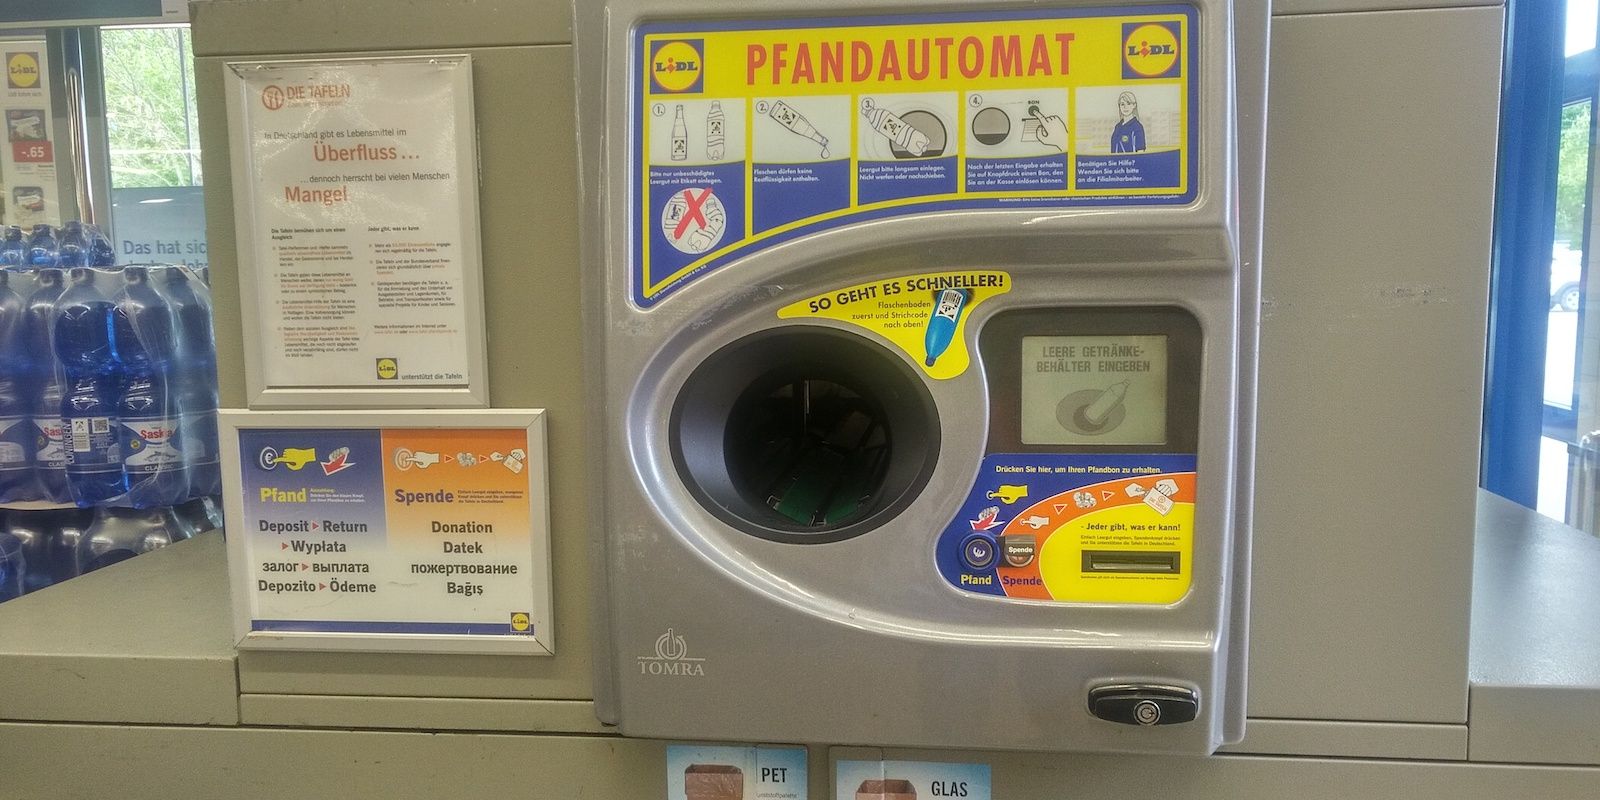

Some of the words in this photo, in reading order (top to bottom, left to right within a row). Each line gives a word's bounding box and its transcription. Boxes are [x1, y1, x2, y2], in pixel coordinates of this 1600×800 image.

[1128, 41, 1174, 58] LIDL
[747, 33, 1075, 85] PFANDAUTOMAT
[10, 65, 37, 74] LIDL
[656, 57, 698, 74] LIDL
[286, 86, 305, 99] DIE
[308, 84, 350, 98] TAFELN
[656, 106, 663, 114] 1.
[760, 103, 767, 111] 2.
[864, 100, 873, 109] 3.
[265, 132, 272, 140] In
[273, 130, 318, 140] Deutschland
[320, 130, 334, 140] gibt
[347, 129, 395, 138] Lebensmittel
[396, 128, 407, 137] im
[21, 146, 45, 158] -.65
[313, 140, 397, 162] Überfluss
[778, 167, 797, 175] dürfen
[1015, 162, 1038, 170] Eingabe
[343, 174, 373, 182] herrscht
[375, 173, 387, 182] bei
[388, 173, 411, 182] vielen
[412, 172, 450, 181] Menschen
[673, 169, 715, 177] unbeschädigtes
[987, 170, 1020, 178] Knopfdruck
[1096, 175, 1144, 183] Filialmitarbeiter.
[285, 185, 347, 206] Mangel
[123, 240, 152, 255] Das
[156, 240, 181, 254] hat
[186, 239, 208, 254] sic
[809, 297, 831, 313] SO
[836, 286, 878, 305] GEHT
[883, 281, 901, 296] ES
[906, 274, 1003, 292] SCHNELLER!
[878, 301, 931, 309] Flaschenboden
[875, 311, 889, 319] und
[891, 311, 928, 319] Strichcode
[1042, 346, 1076, 358] LEERE
[1082, 343, 1144, 358] GETRÄNKE-
[1036, 358, 1091, 372] BEHÄLTER
[1098, 360, 1151, 372] EINGEBEN
[996, 465, 1024, 473] Drücken
[1038, 466, 1053, 474] hier,
[1087, 466, 1120, 474] Pfandbon
[1132, 466, 1162, 474] erhalten.
[260, 487, 307, 503] Pfand
[394, 489, 454, 506] Spende
[259, 520, 309, 535] Deposit
[322, 520, 368, 533] Return
[431, 521, 493, 533] Donation
[1110, 523, 1127, 532] gibt,
[291, 540, 347, 556] Wypłata
[443, 542, 483, 554] Datek
[1008, 546, 1033, 554] Spende
[262, 562, 299, 572] залог
[312, 563, 369, 573] выплата
[411, 564, 517, 576] пожертвование
[960, 574, 992, 585] Pfand
[1003, 575, 1042, 587] Spende
[258, 580, 316, 595] Depozito
[330, 577, 377, 593] Ödeme
[446, 581, 483, 597] Bağış
[637, 661, 705, 676] TOMRA
[761, 767, 788, 783] PET
[931, 781, 968, 797] GLAS
